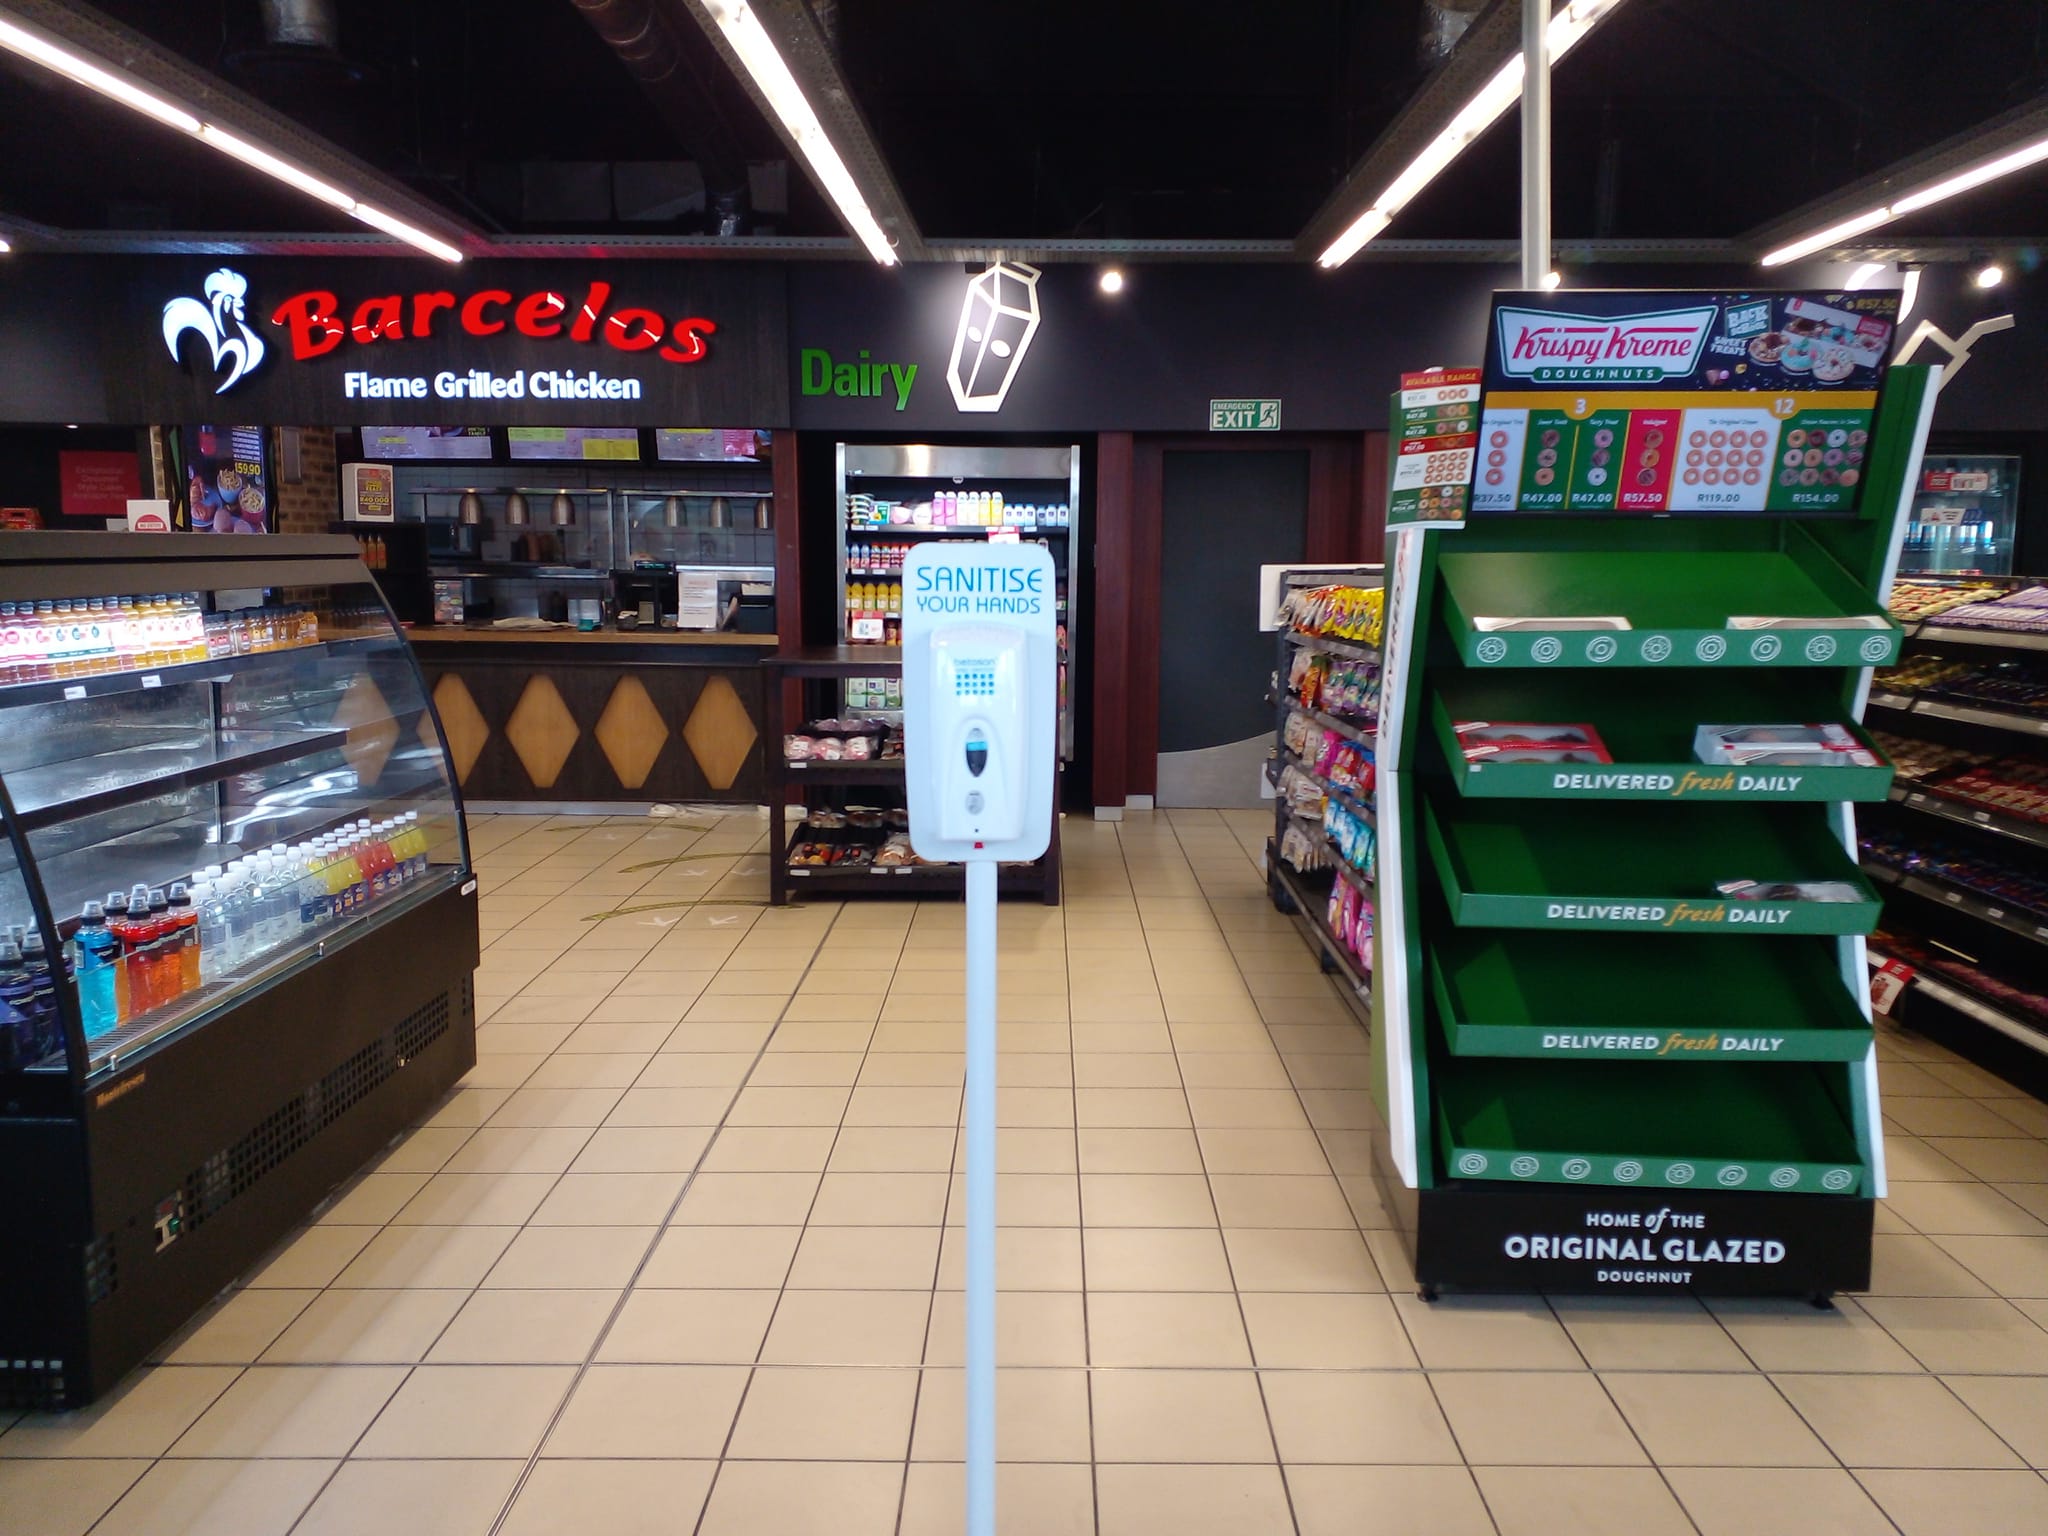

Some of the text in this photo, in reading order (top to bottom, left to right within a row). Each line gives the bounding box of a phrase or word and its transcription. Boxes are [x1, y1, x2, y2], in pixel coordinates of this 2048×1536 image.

[271, 282, 717, 364] Barcelos
[1511, 326, 1700, 364] Krispy Kreme
[344, 369, 642, 399] Flame Grilled Chicken
[800, 348, 918, 411] Dairy
[1406, 372, 1477, 386] AVAILABLE RANGE
[1541, 368, 1655, 379] DOUGHNUTS
[1213, 402, 1256, 410] EMERGENCY
[1574, 399, 1587, 414] 3
[1774, 398, 1795, 414] 12
[1213, 411, 1256, 428] EXIT
[1522, 493, 1563, 503] R47.00
[1571, 493, 1613, 503] R47.00
[1622, 493, 1663, 503] R57.50
[1697, 493, 1840, 503] R119.00 R154.00
[915, 566, 1043, 593] SANITISE
[916, 596, 1041, 614] YOUR HANDS
[1552, 771, 1803, 796] DELIVERED fresh DAILY
[1546, 903, 1792, 927] DELIVERED fresh DAILY
[1541, 1032, 1785, 1056] DELIVERED fresh DAILY
[1585, 1207, 1706, 1234] HOME of THE
[1503, 1234, 1787, 1264] ORIGINAL GLAZED
[1597, 1269, 1693, 1285] DOUGHNUT
